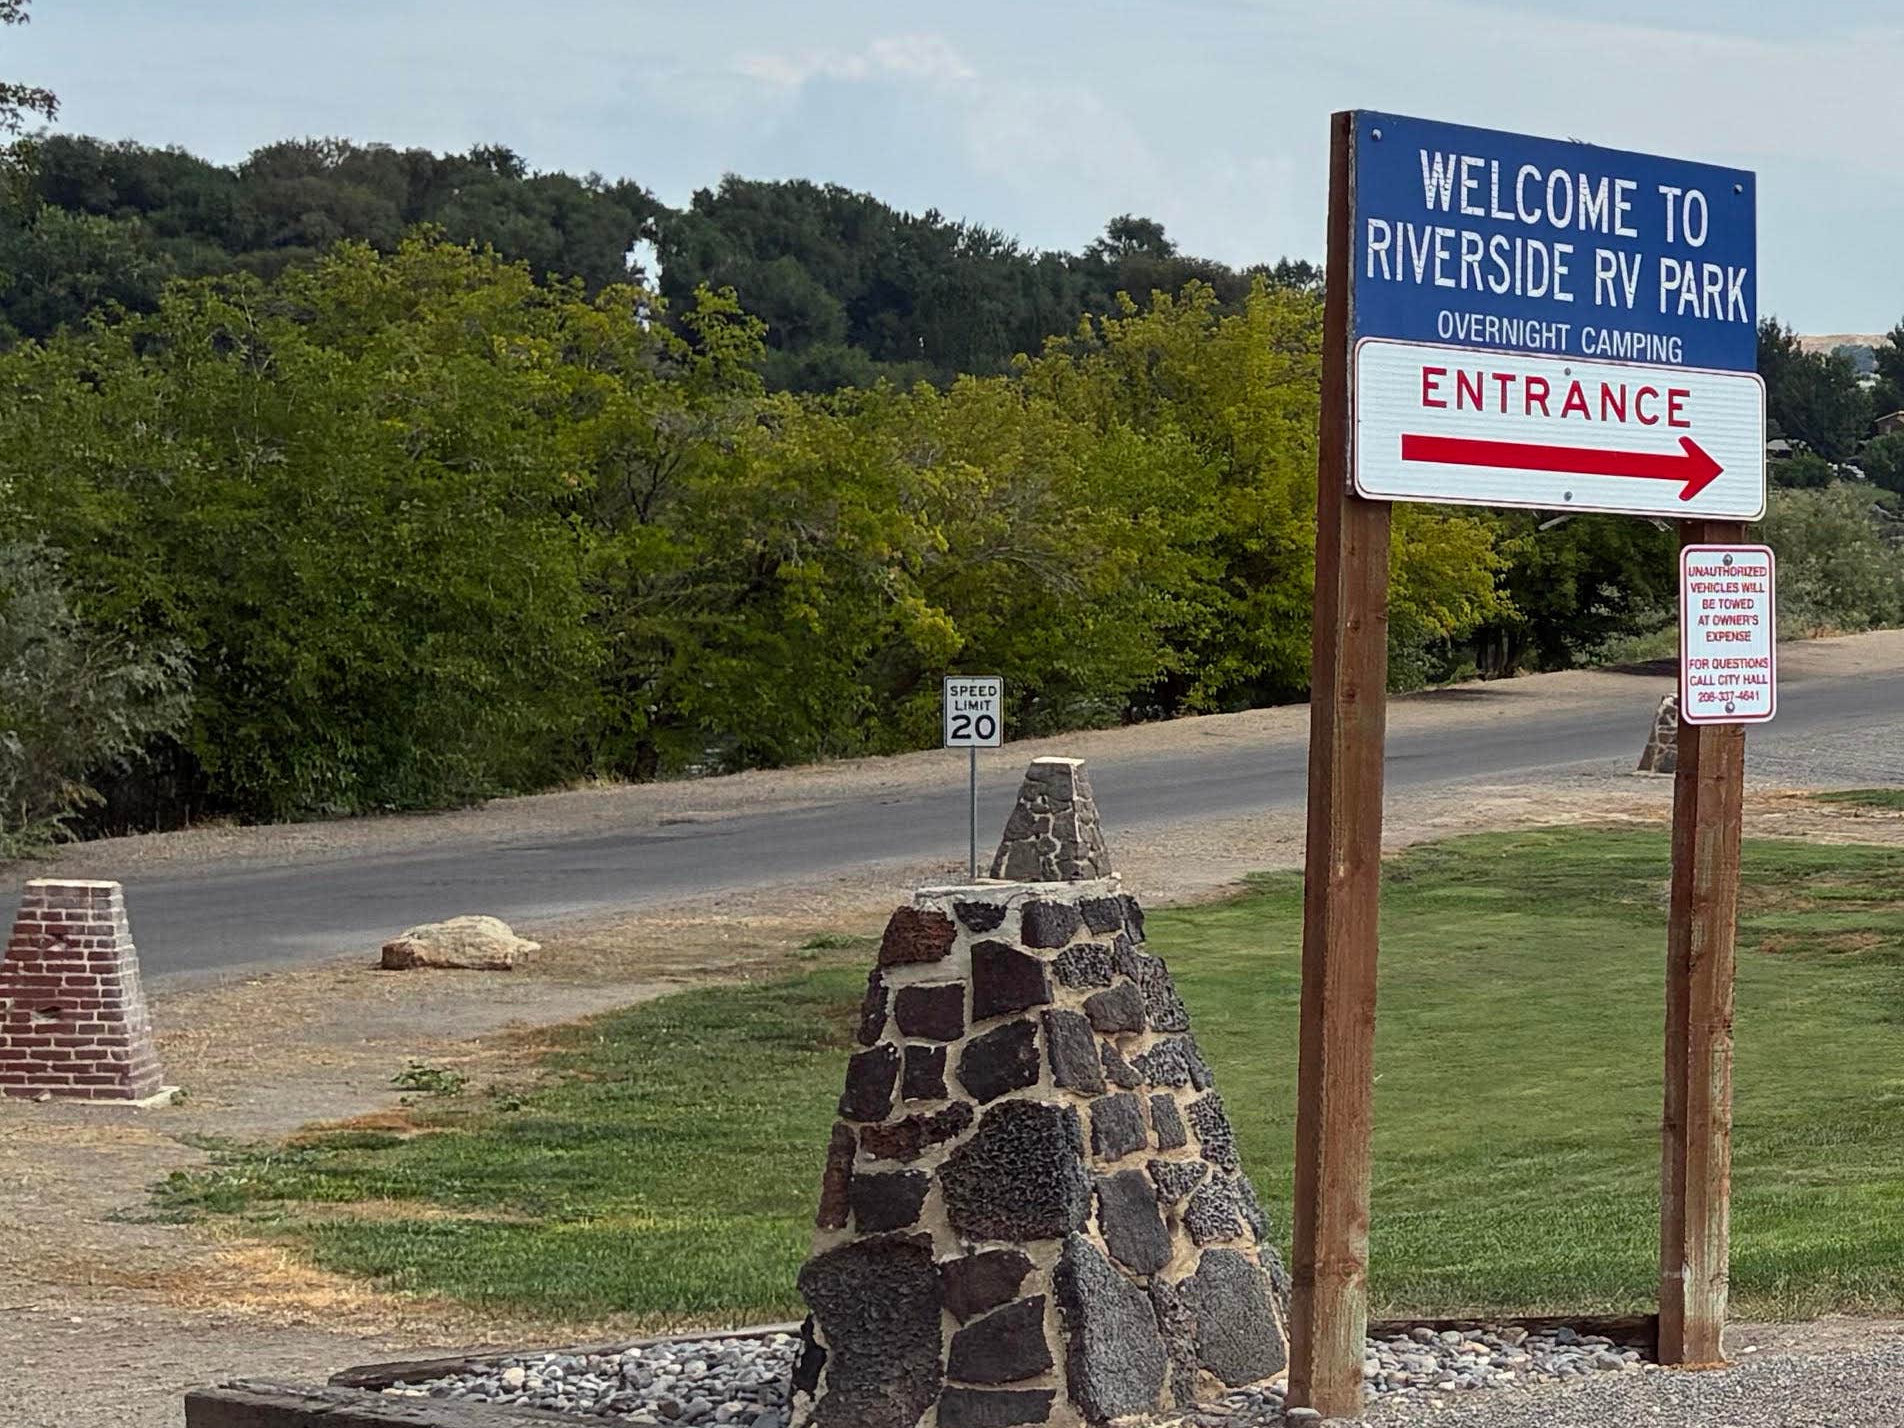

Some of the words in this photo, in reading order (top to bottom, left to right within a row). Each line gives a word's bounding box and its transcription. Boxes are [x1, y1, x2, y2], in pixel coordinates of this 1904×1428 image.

[1420, 149, 1638, 238] WELCOME
[1659, 184, 1709, 247] TO
[1367, 218, 1574, 302] RIVERSIDE
[1595, 248, 1642, 310] RV
[1659, 257, 1748, 323] PARK
[1438, 310, 1571, 352] OVERNIGHT
[1581, 327, 1683, 364] CAMPING
[1422, 365, 1691, 428] ENTRANCE
[1688, 566, 1767, 577] UNAUTHORIZED
[1691, 583, 1739, 593] VEHICLES
[1741, 583, 1765, 593] WILL
[1702, 599, 1715, 609] BE
[1718, 599, 1754, 609] TOWED
[1698, 616, 1710, 626] AT
[1712, 615, 1759, 626] OWNER'S
[1706, 631, 1751, 642] EXPENSE
[1689, 659, 1710, 669] FOR
[1712, 658, 1768, 669] QUESTIONS
[1690, 675, 1715, 686] CALL
[1718, 675, 1739, 685] CITY
[1743, 674, 1768, 685] HALL
[950, 685, 997, 697] SPEED
[955, 700, 992, 711] LIMIT
[951, 714, 996, 740] 20
